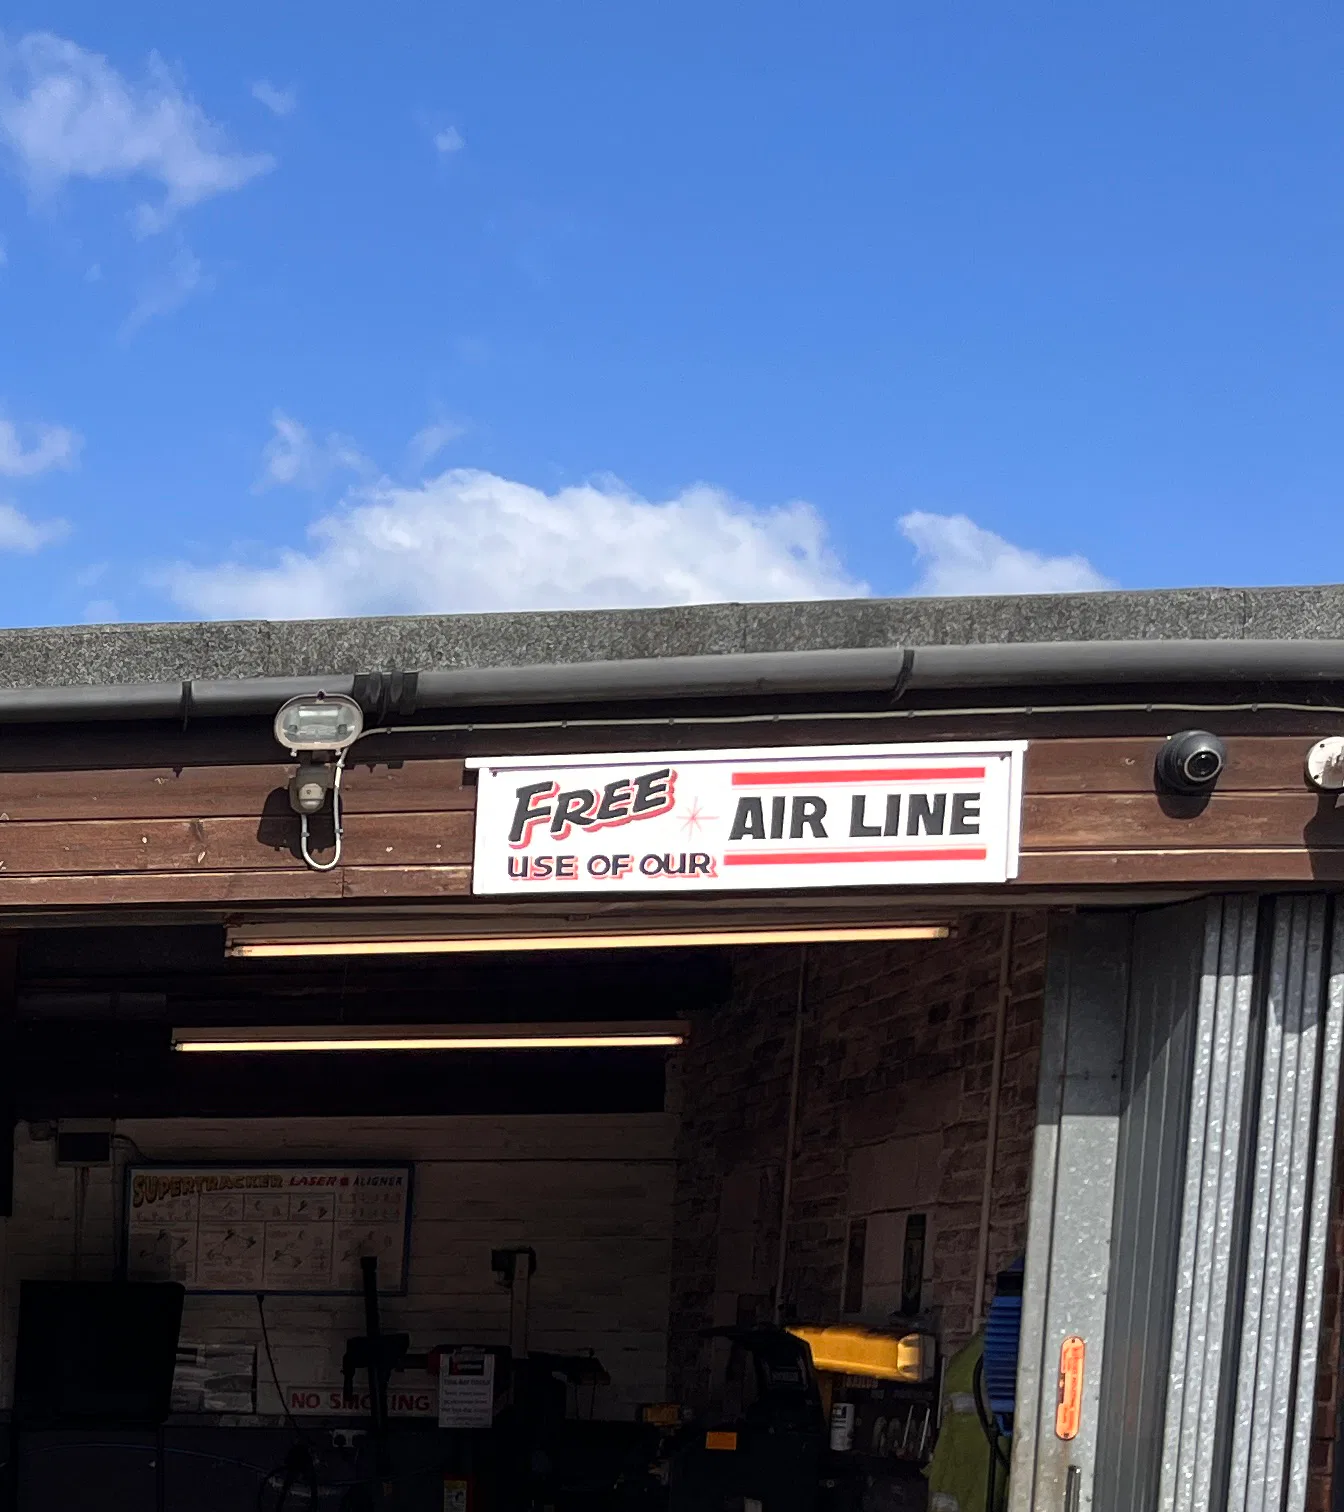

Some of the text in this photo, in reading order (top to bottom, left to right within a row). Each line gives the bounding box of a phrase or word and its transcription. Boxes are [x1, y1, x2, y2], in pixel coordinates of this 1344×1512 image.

[508, 768, 676, 849] FREE
[728, 792, 981, 841] AIR LINE
[508, 851, 718, 880] USE OF OUR
[132, 1173, 404, 1208] SUPERTRACKER LASER ALIGNER
[291, 1392, 322, 1410] NO
[328, 1391, 431, 1412] SMOING
